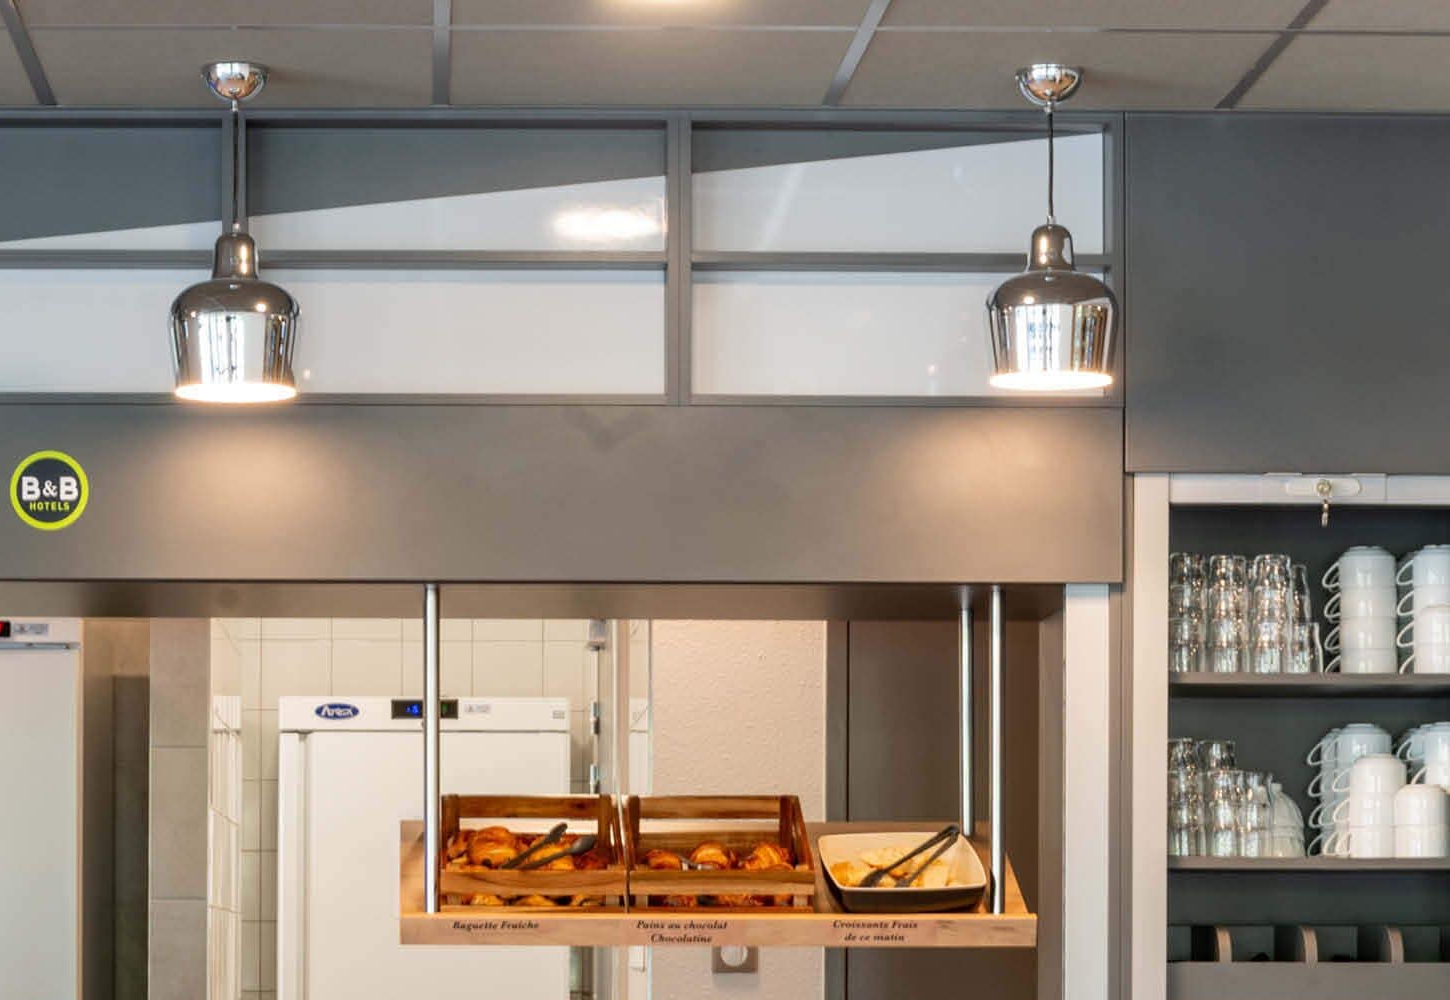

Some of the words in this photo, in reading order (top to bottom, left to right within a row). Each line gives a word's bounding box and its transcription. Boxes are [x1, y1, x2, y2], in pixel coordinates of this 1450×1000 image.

[21, 475, 79, 501] B&B
[29, 501, 70, 512] HOTELS
[453, 919, 498, 932] Baguette
[637, 919, 665, 930] Pains
[668, 921, 681, 930] au
[684, 919, 728, 930] chocolat
[833, 919, 889, 930] Croissants
[892, 919, 918, 930] Frais
[651, 932, 712, 944] Chocolatine
[845, 932, 857, 942] de
[860, 934, 870, 942] ce
[874, 932, 905, 942] matin
